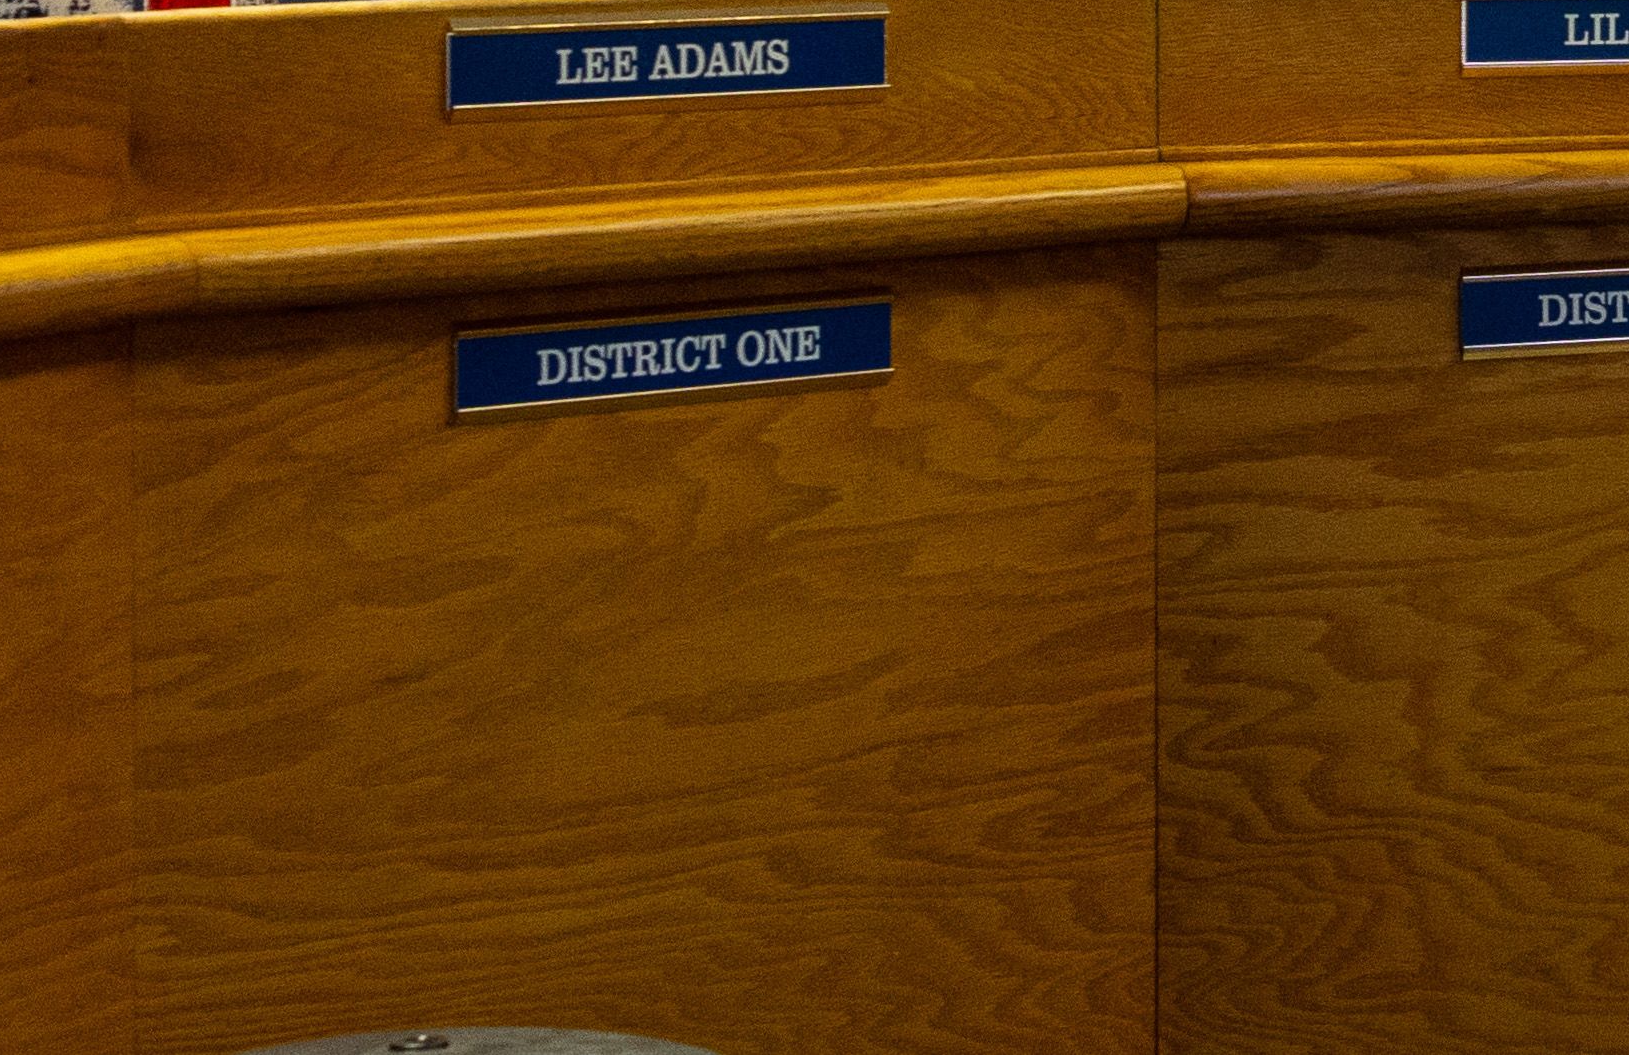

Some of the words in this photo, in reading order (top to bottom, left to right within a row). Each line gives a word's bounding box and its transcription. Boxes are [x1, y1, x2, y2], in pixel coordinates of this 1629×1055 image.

[556, 45, 638, 85] LEE
[648, 38, 791, 82] ADAMS
[536, 333, 727, 386] DISTRICT
[736, 325, 822, 368] ONE
